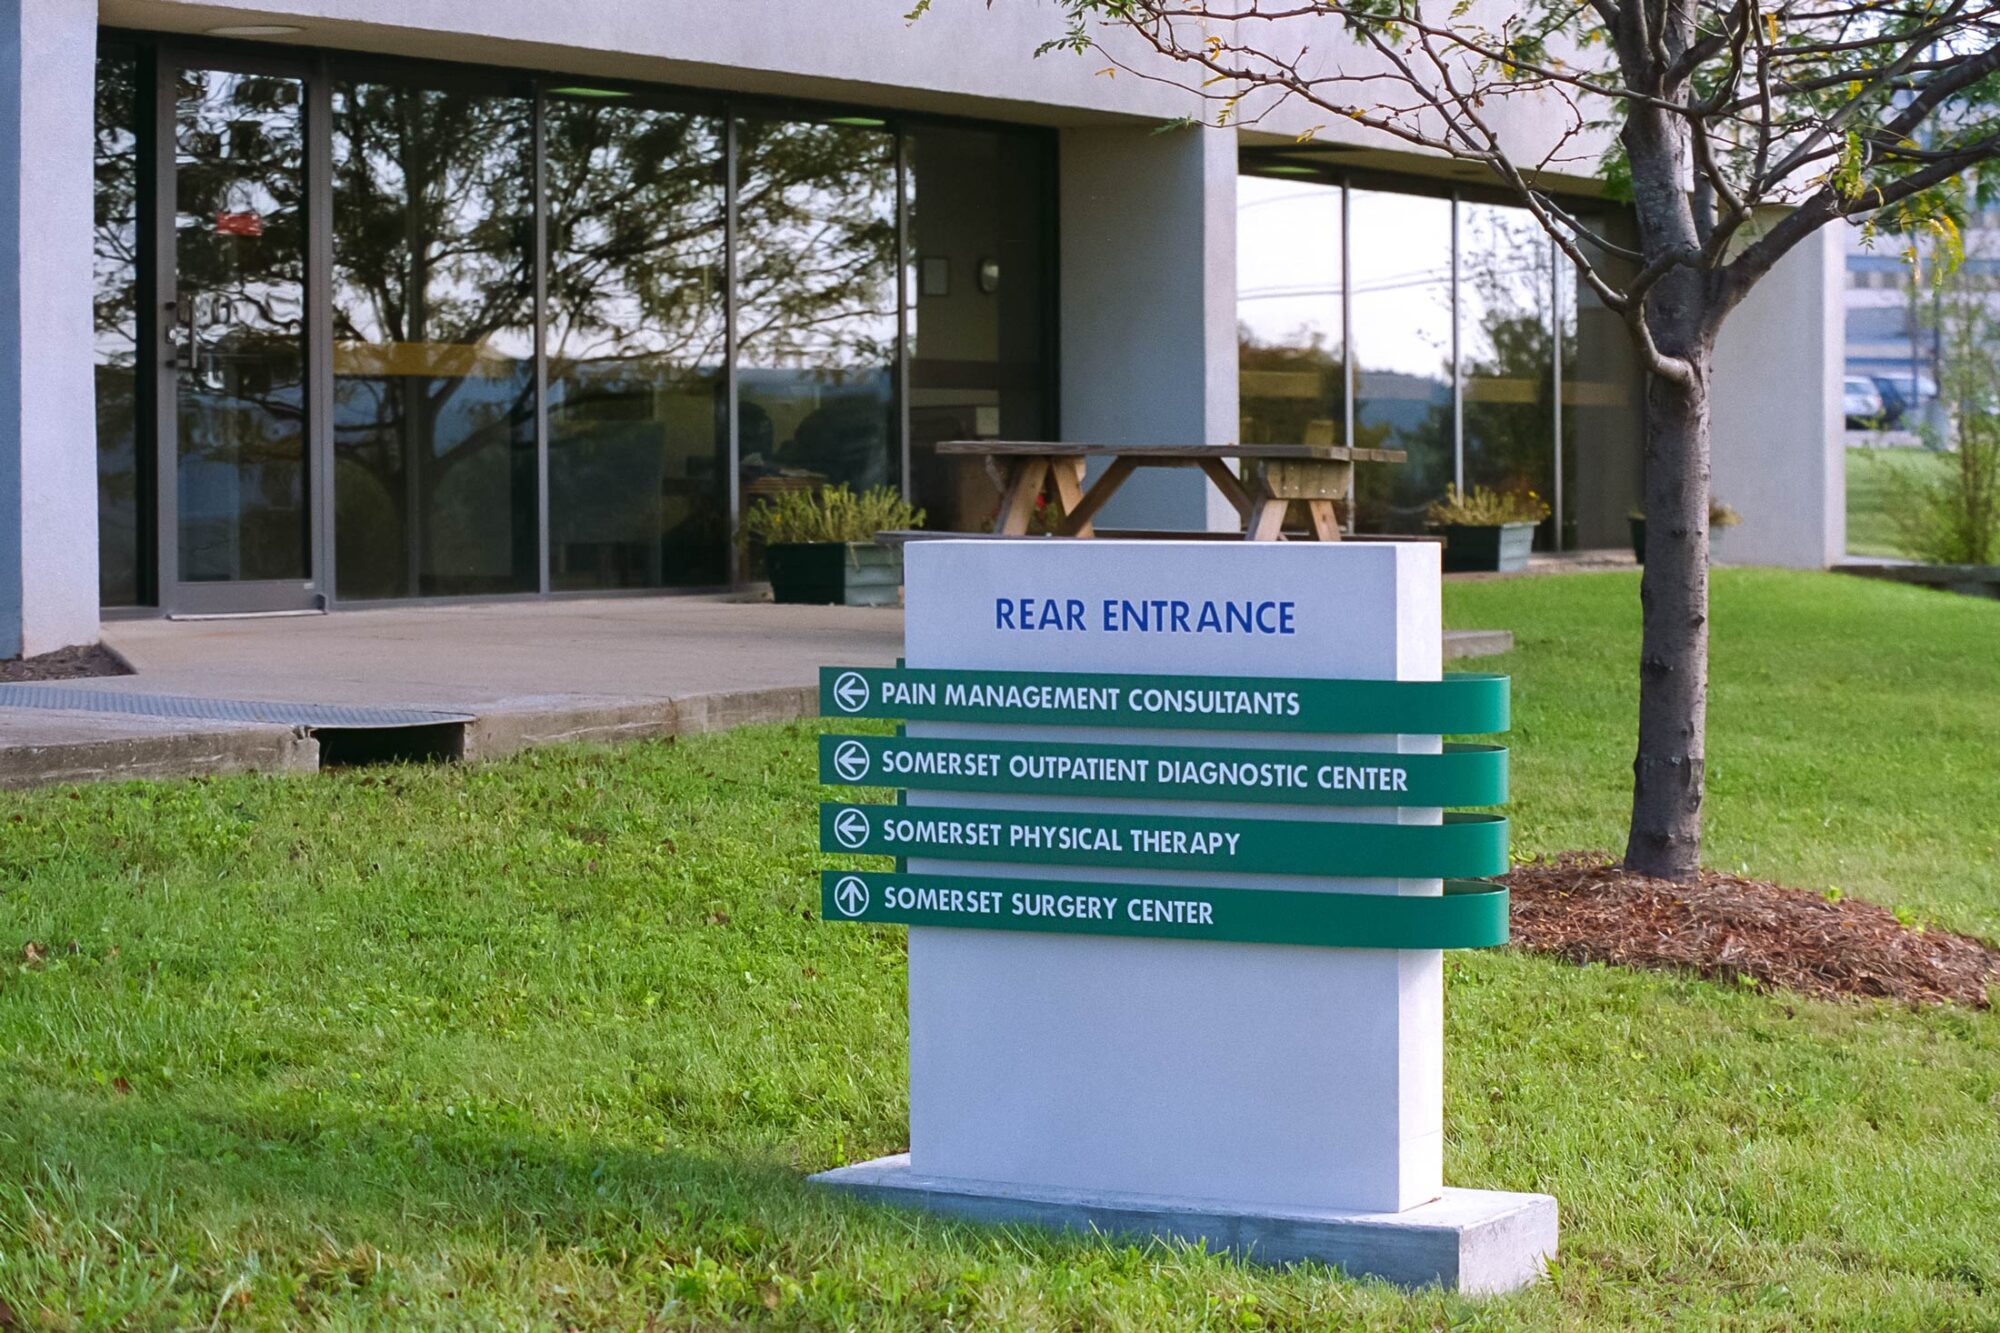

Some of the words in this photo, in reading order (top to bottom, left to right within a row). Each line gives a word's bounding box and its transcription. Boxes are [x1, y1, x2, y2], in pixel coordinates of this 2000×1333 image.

[996, 598, 1086, 631] REAR
[1103, 600, 1295, 634] ENTRANCE
[883, 683, 935, 704] PAIN
[945, 685, 1119, 710] MANAGEMENT
[1129, 689, 1299, 715] CONSULTANTS
[883, 751, 1000, 776] SOMERSET
[1010, 756, 1148, 781] OUTPATIENT
[1159, 761, 1307, 787] DIAGNOSTIC
[1318, 766, 1407, 791] CENTER
[884, 820, 1001, 845] SOMERSET
[1011, 826, 1122, 850] PHYSICAL
[1131, 830, 1240, 855] THERAPY
[885, 887, 1002, 913] SOMERSET
[1013, 894, 1117, 919] SURGERY
[1128, 899, 1213, 924] CENTER
